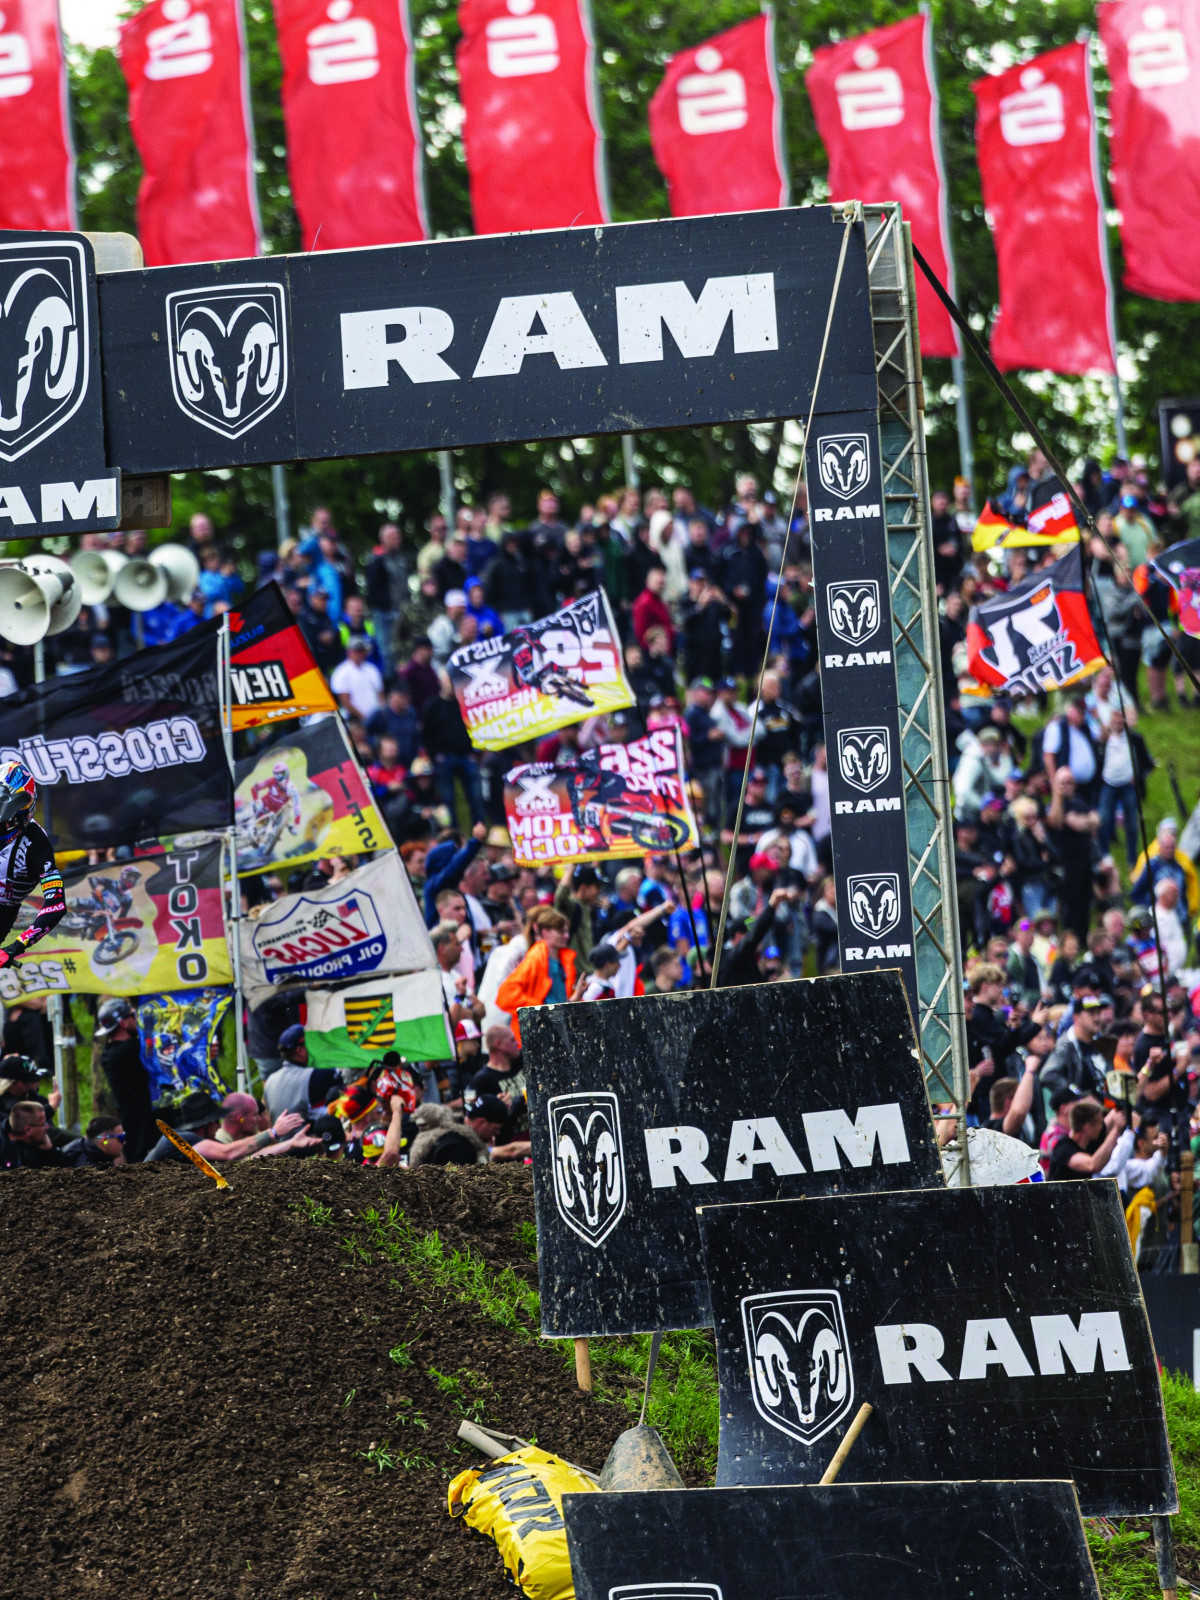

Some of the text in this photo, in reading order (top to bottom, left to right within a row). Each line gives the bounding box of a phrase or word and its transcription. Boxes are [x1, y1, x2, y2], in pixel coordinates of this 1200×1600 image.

[340, 272, 778, 390] RAM
[815, 504, 881, 521] RAM
[825, 651, 891, 668] RAM
[835, 797, 901, 814] RAM
[846, 944, 911, 960] RAM
[644, 1103, 910, 1188] RAM
[874, 1311, 1132, 1384] RAM
